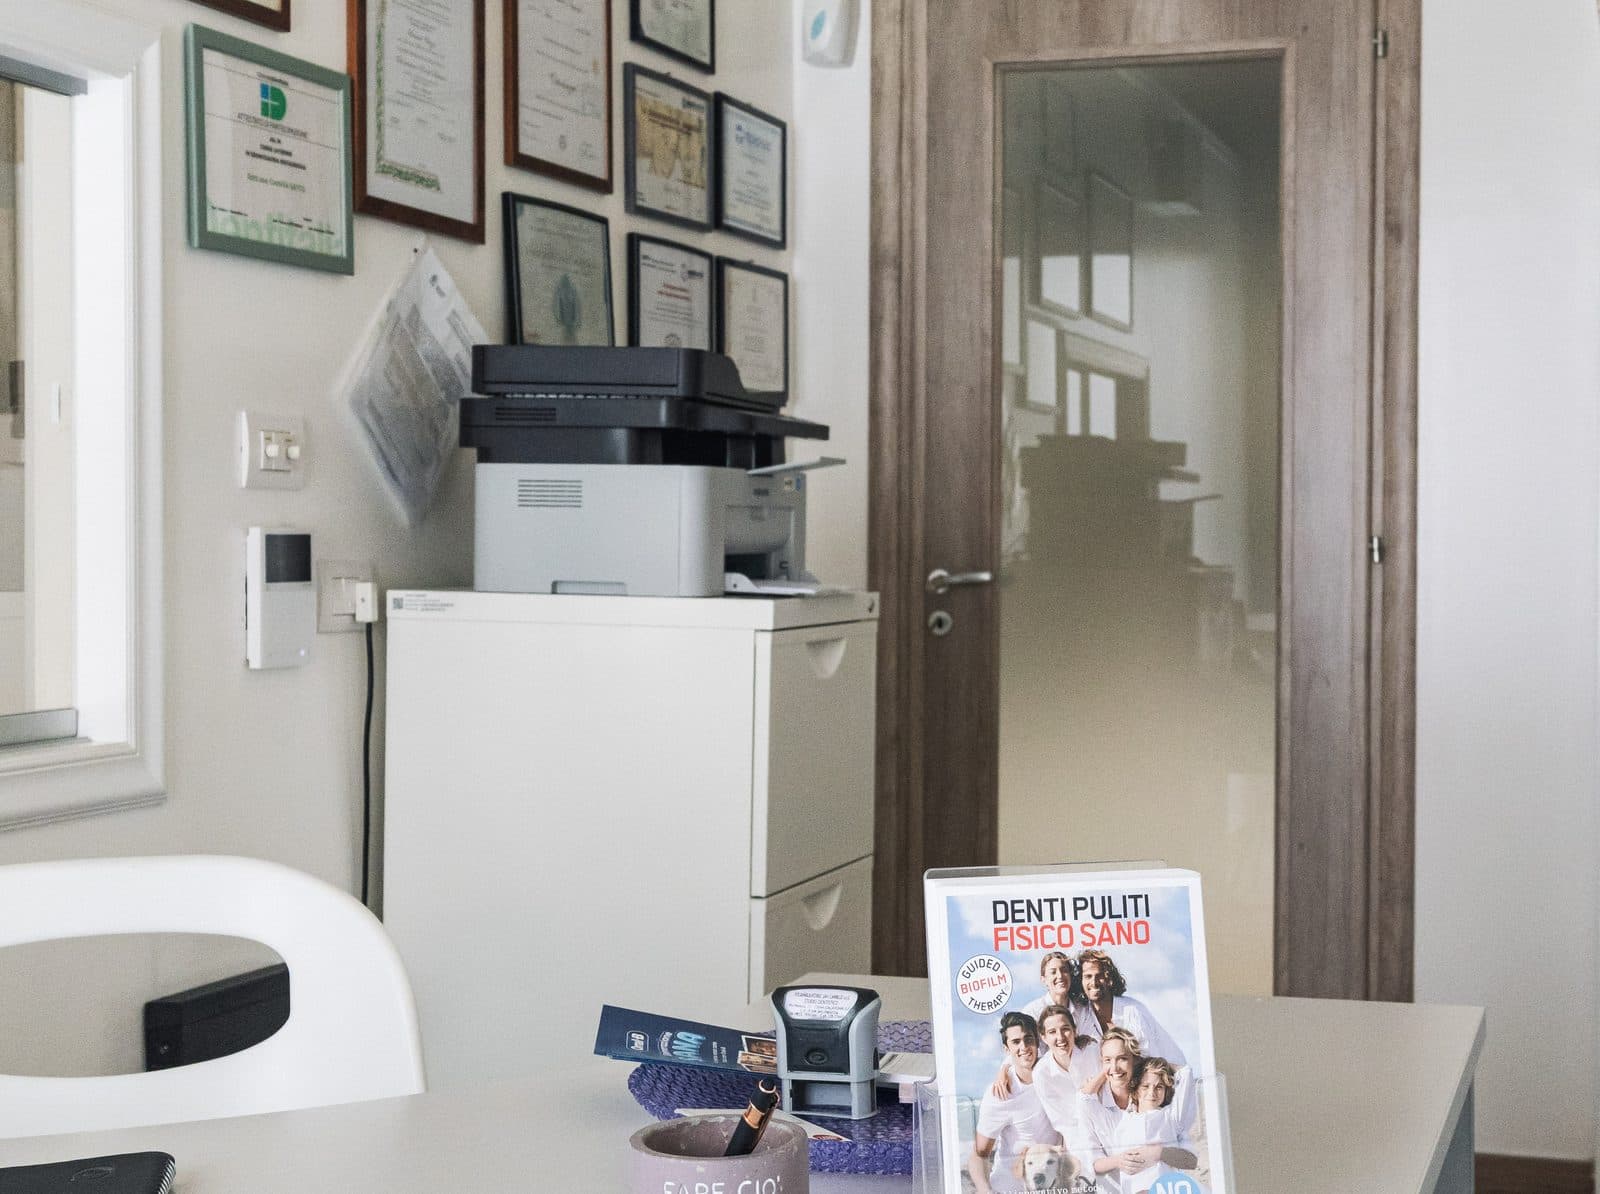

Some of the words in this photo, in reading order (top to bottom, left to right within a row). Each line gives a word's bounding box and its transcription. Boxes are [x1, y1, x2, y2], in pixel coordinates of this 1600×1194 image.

[992, 897, 1066, 925] DENTI
[1072, 894, 1150, 920] PULITI
[993, 923, 1074, 951] FISICO
[1080, 920, 1151, 947] SANO
[961, 958, 1001, 979] GUIDED
[960, 973, 1007, 994] BIOFILM
[968, 988, 1008, 1011] THERAPY
